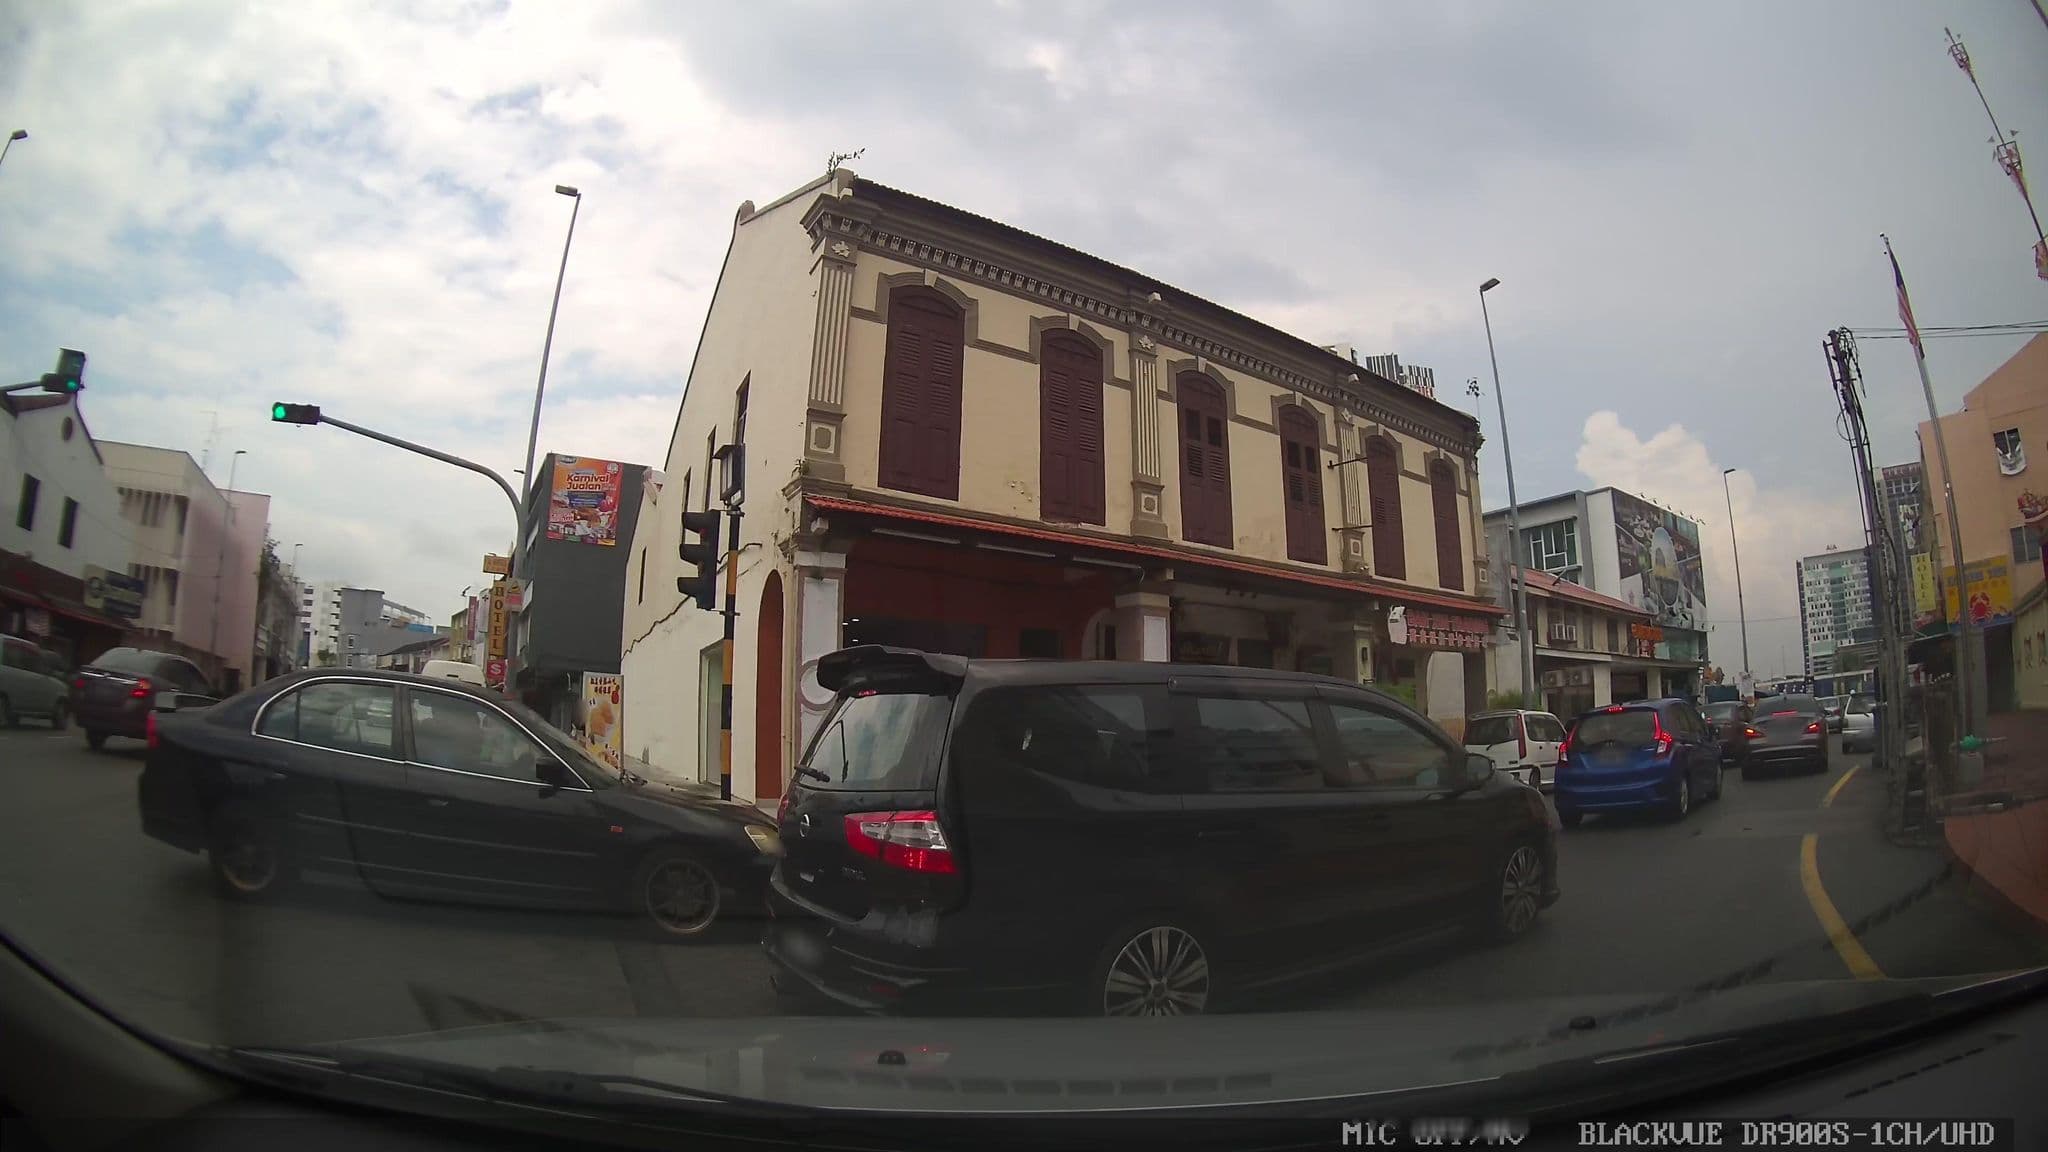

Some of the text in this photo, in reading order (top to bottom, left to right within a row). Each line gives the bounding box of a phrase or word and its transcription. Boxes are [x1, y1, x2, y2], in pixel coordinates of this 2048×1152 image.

[566, 473, 609, 483] Karnival
[566, 480, 601, 491] Jualan
[493, 586, 505, 650] HOTEL
